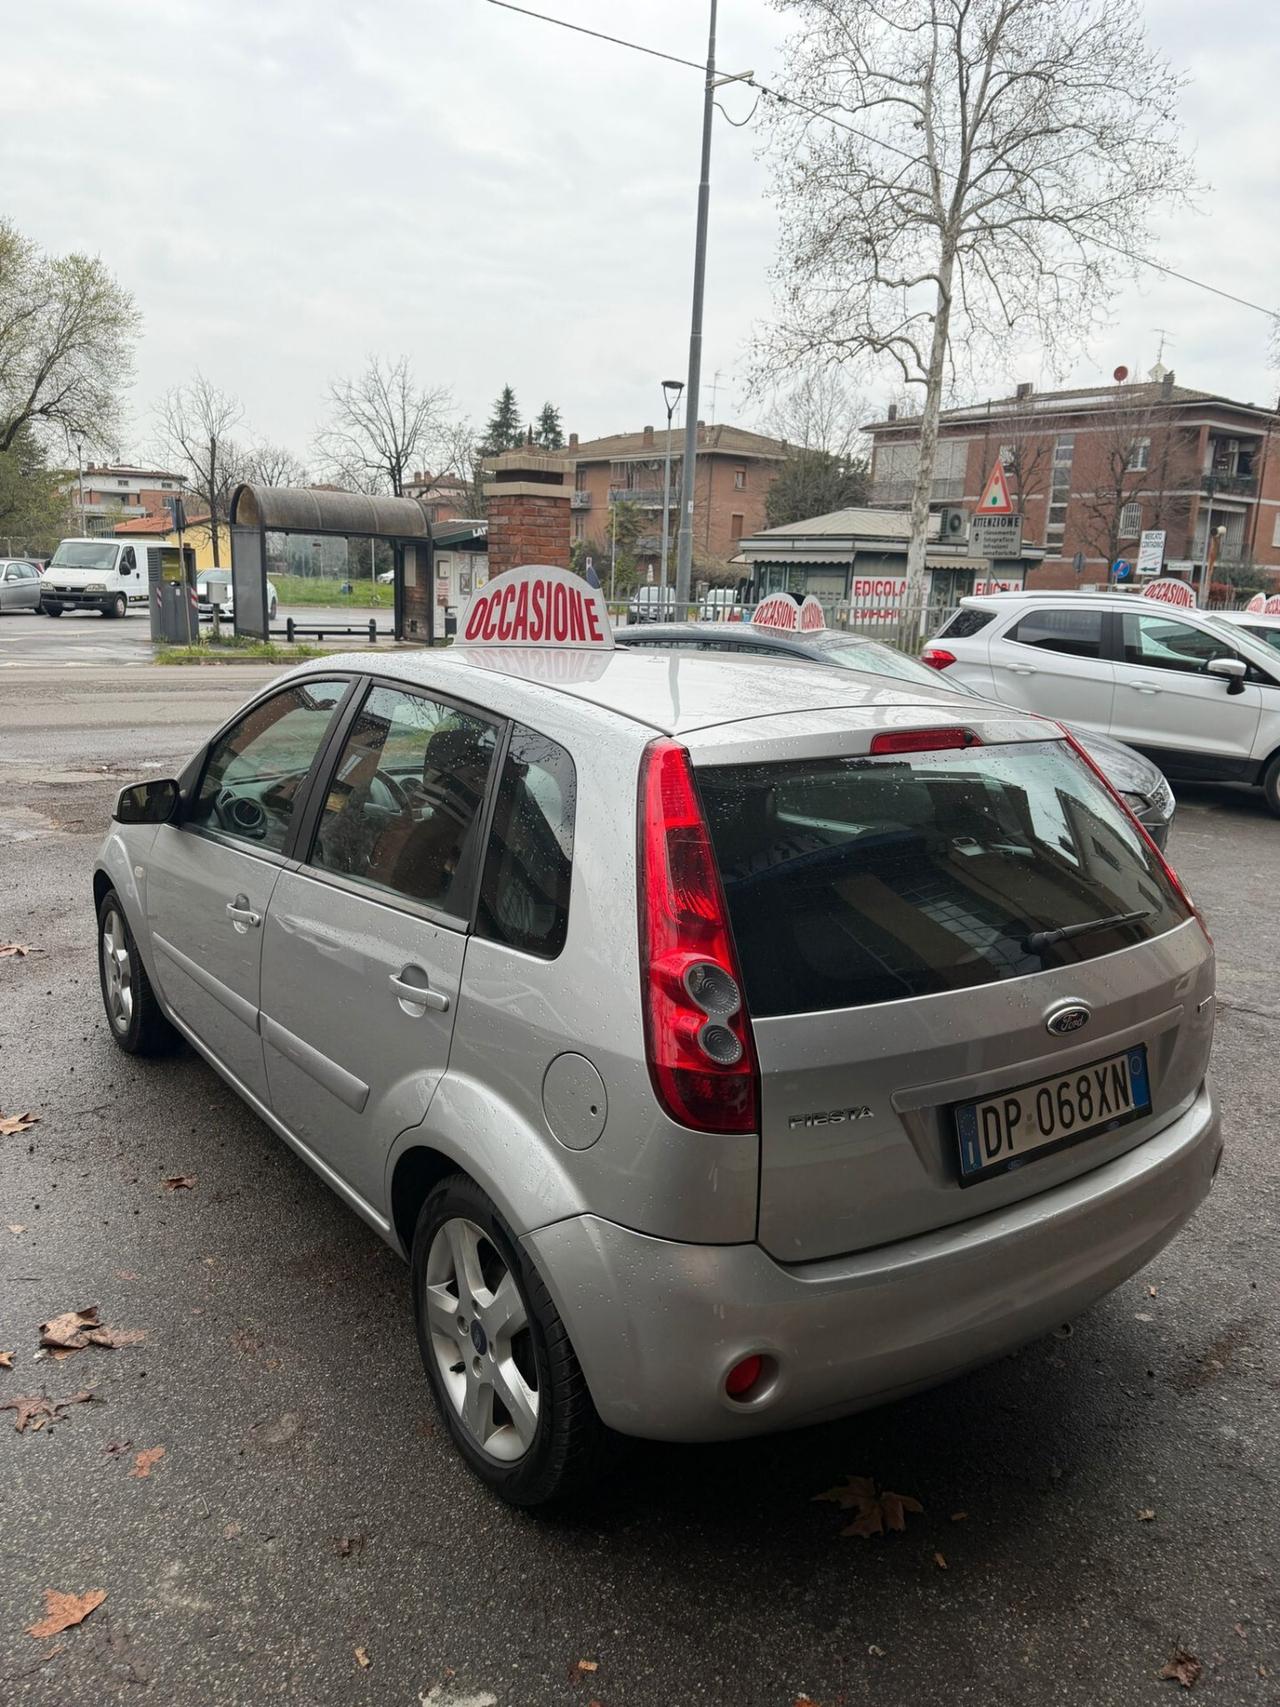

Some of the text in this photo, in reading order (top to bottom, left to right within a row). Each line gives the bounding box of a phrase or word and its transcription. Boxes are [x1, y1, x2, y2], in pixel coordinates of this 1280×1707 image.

[973, 517, 1020, 528] ATTENZIONE
[854, 580, 907, 597] EDICOLA
[1144, 582, 1194, 609] OCCASIONE
[465, 579, 606, 642] OCCASIONE
[753, 600, 797, 630] OCCASIONE
[1060, 1012, 1084, 1031] Ford
[788, 1105, 875, 1130] FIESTA
[981, 1097, 1022, 1159] DP
[1036, 1060, 1130, 1136] 068XN
